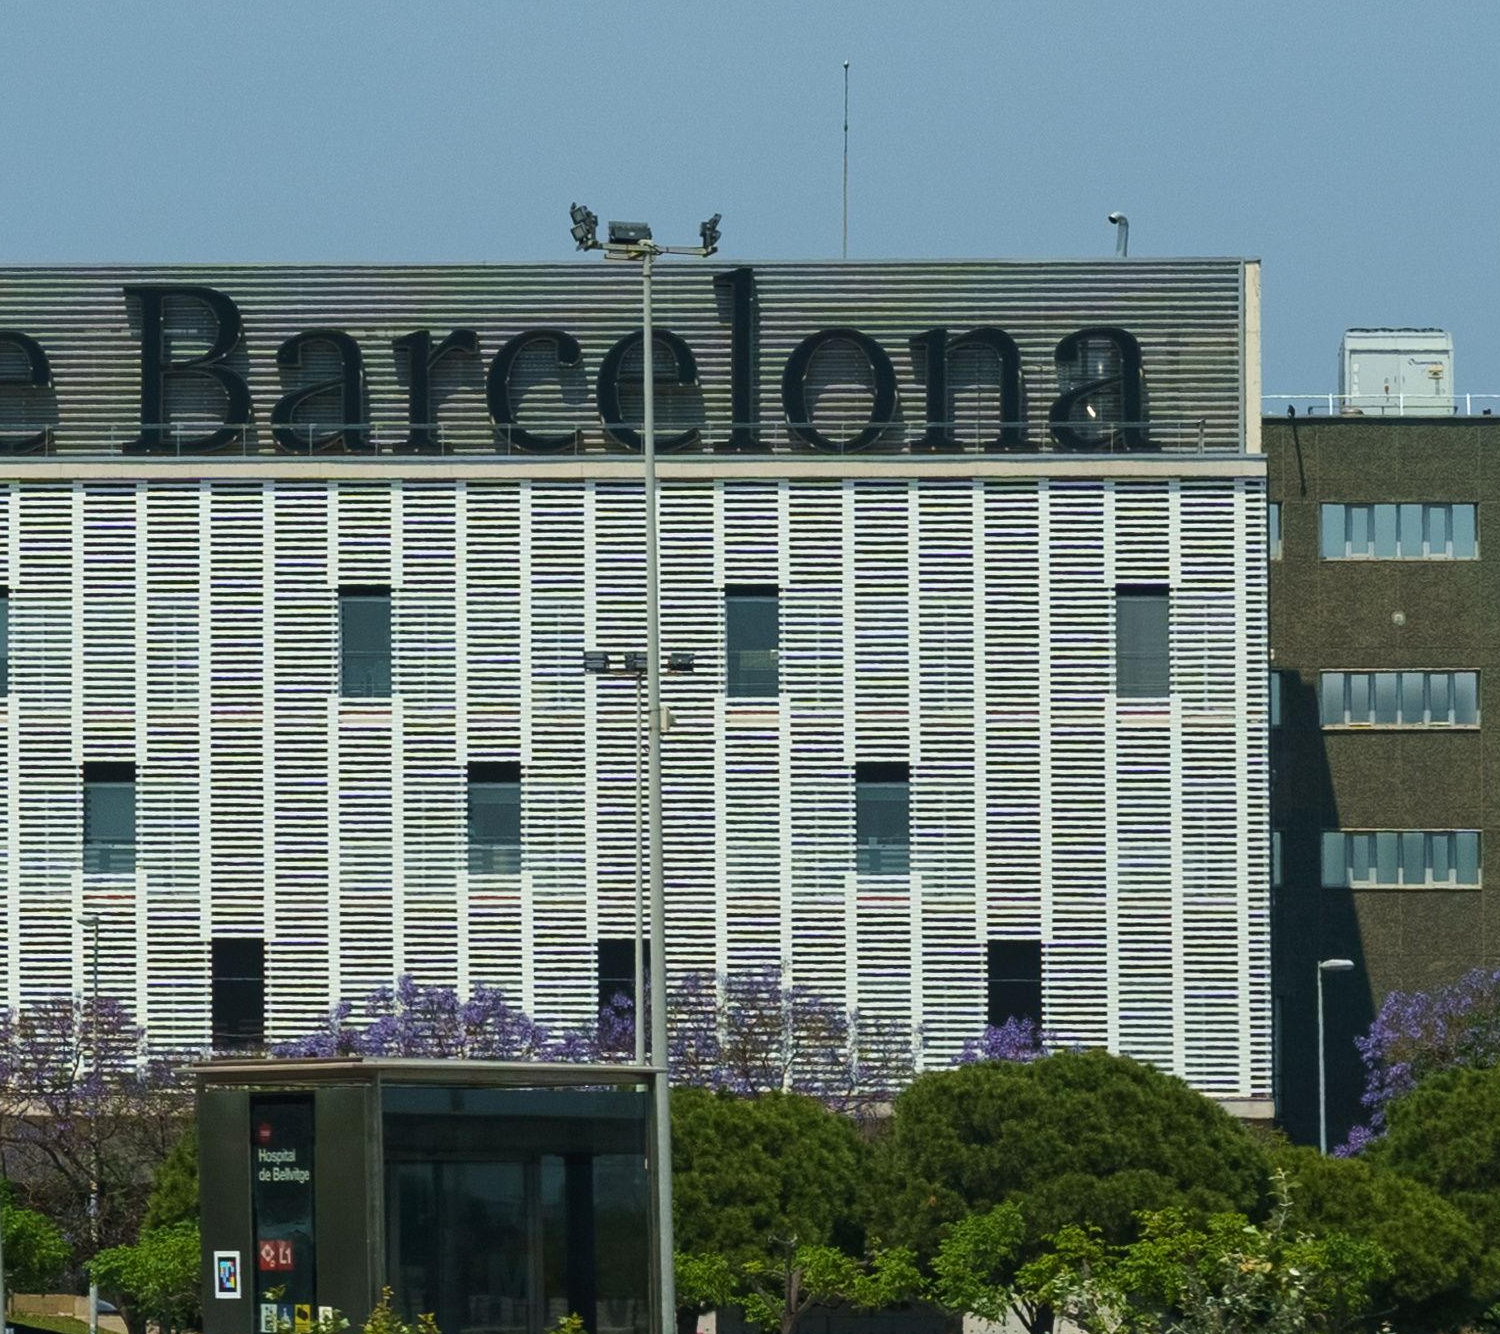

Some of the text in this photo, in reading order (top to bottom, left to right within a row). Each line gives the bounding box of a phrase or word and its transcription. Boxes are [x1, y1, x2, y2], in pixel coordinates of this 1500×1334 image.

[122, 267, 1162, 455] Barcelona
[258, 1148, 296, 1165] Hospital
[258, 1167, 310, 1184] de Bellvitge
[279, 1246, 291, 1264] L1
